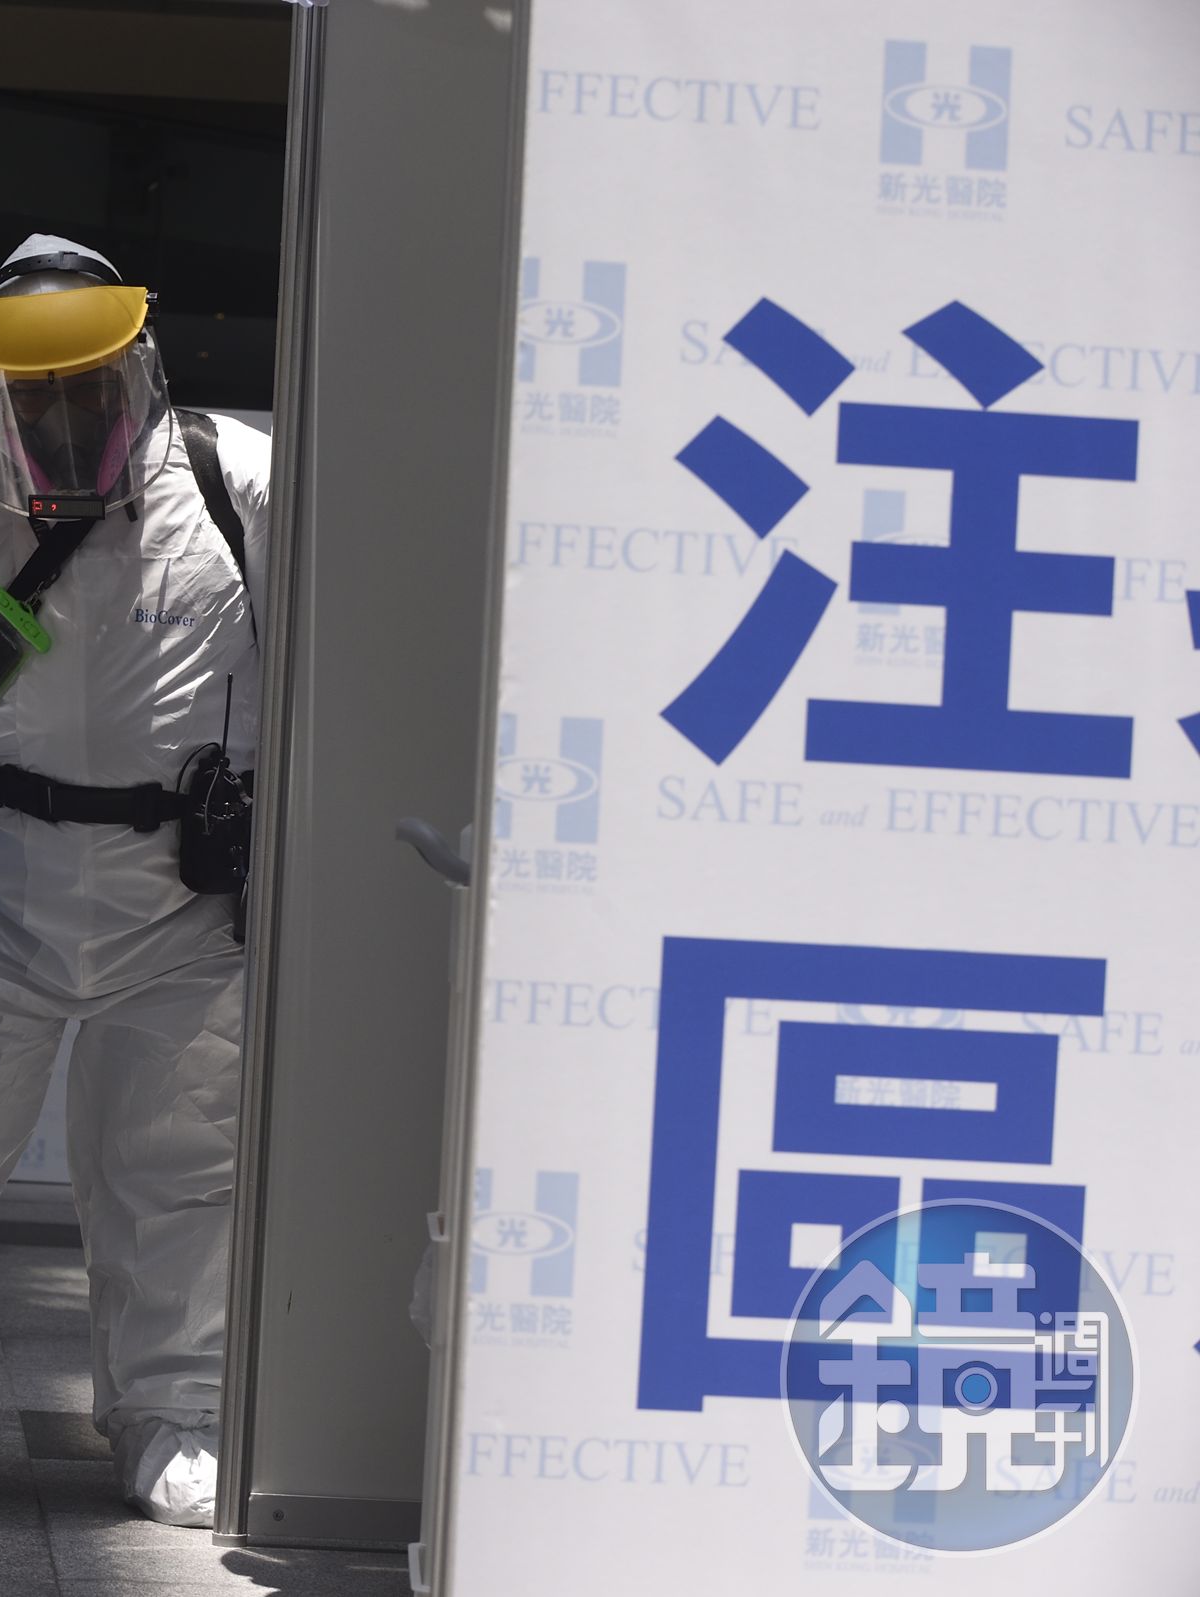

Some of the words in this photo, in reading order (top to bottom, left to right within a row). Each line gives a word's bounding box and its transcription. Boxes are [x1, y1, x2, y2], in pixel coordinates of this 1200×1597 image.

[877, 172, 1007, 208] 新光醫院
[660, 296, 1200, 778] 注
[135, 608, 195, 627] BioCover
[656, 774, 804, 827] SAFE
[819, 803, 869, 828] and
[884, 787, 1200, 848] EFFECTIVE
